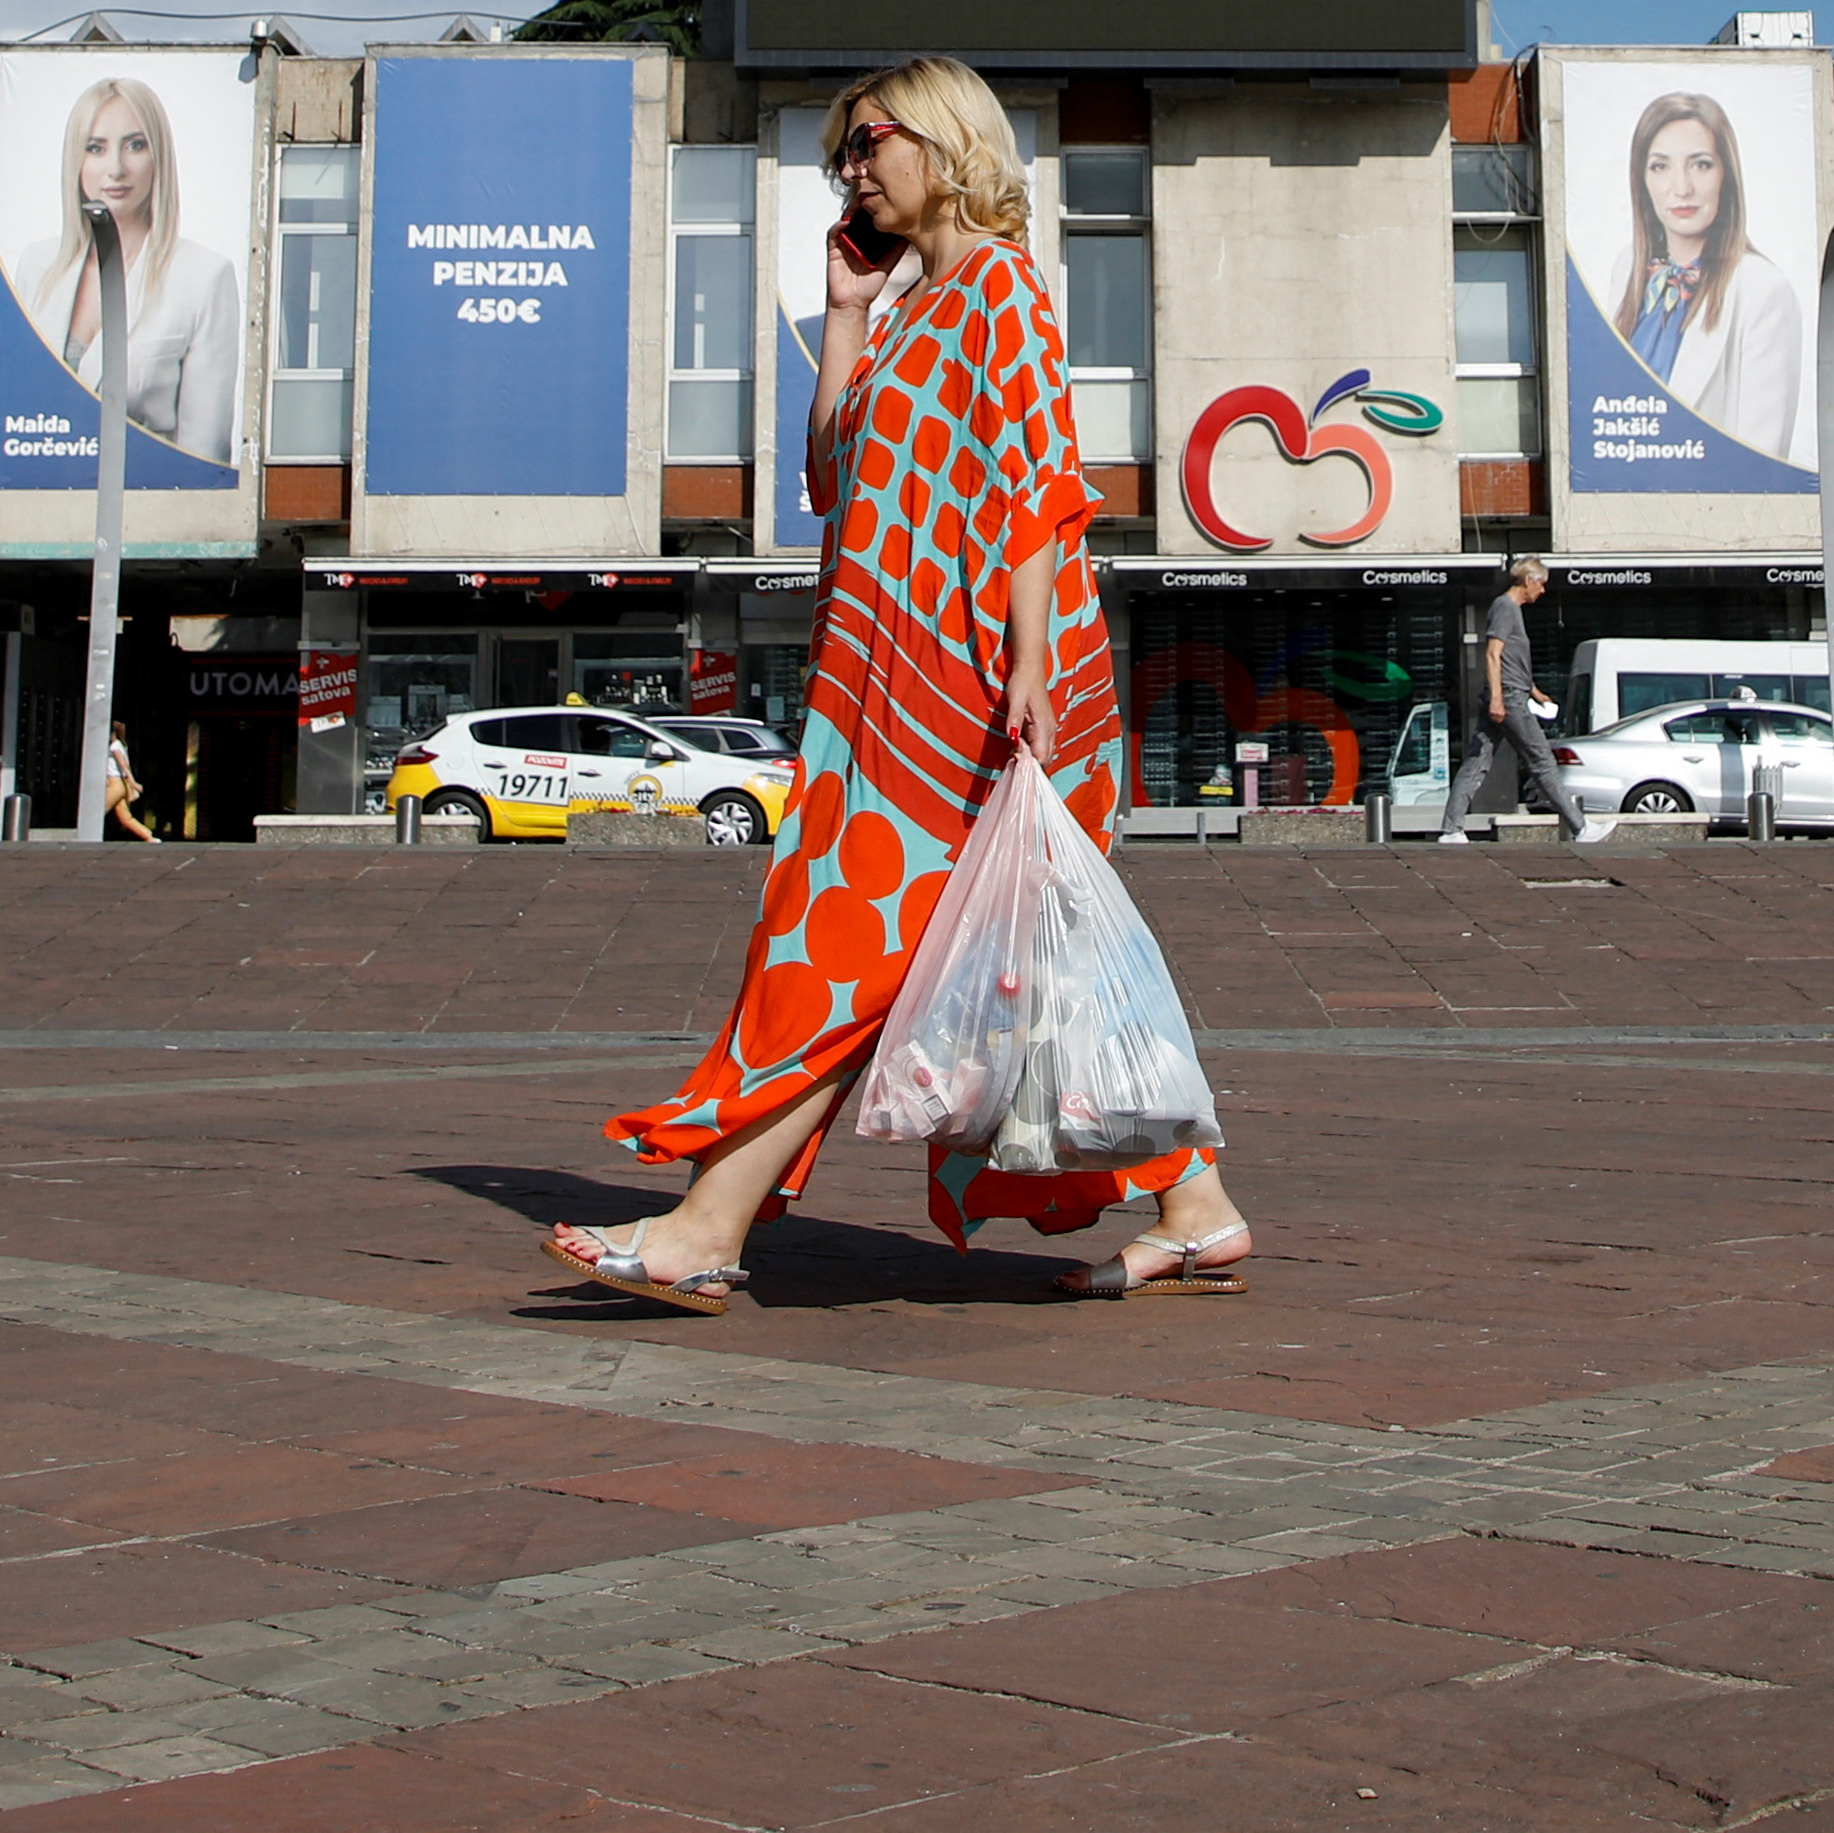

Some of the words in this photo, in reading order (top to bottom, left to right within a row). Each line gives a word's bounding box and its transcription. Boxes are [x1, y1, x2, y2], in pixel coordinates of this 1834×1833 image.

[407, 223, 596, 251] MINIMALNA
[432, 260, 569, 288] PENZIJA
[456, 298, 541, 325] 450€
[1592, 395, 1668, 415] Anđela
[5, 413, 71, 434] Maida
[1592, 417, 1660, 440] Jakšić
[3, 436, 99, 457] Gorčević
[1592, 438, 1705, 463] Stojanović
[755, 574, 820, 590] Cosmet
[1161, 570, 1248, 587] Cosmetics
[1362, 569, 1448, 585] Cosmetics
[1567, 569, 1652, 585] Cosmetics
[1767, 567, 1825, 584] Cosme
[299, 668, 357, 694] SERVIS
[691, 672, 736, 691] SERVIS
[301, 685, 351, 706] satova
[692, 684, 731, 701] satova
[499, 773, 568, 799] 19711
